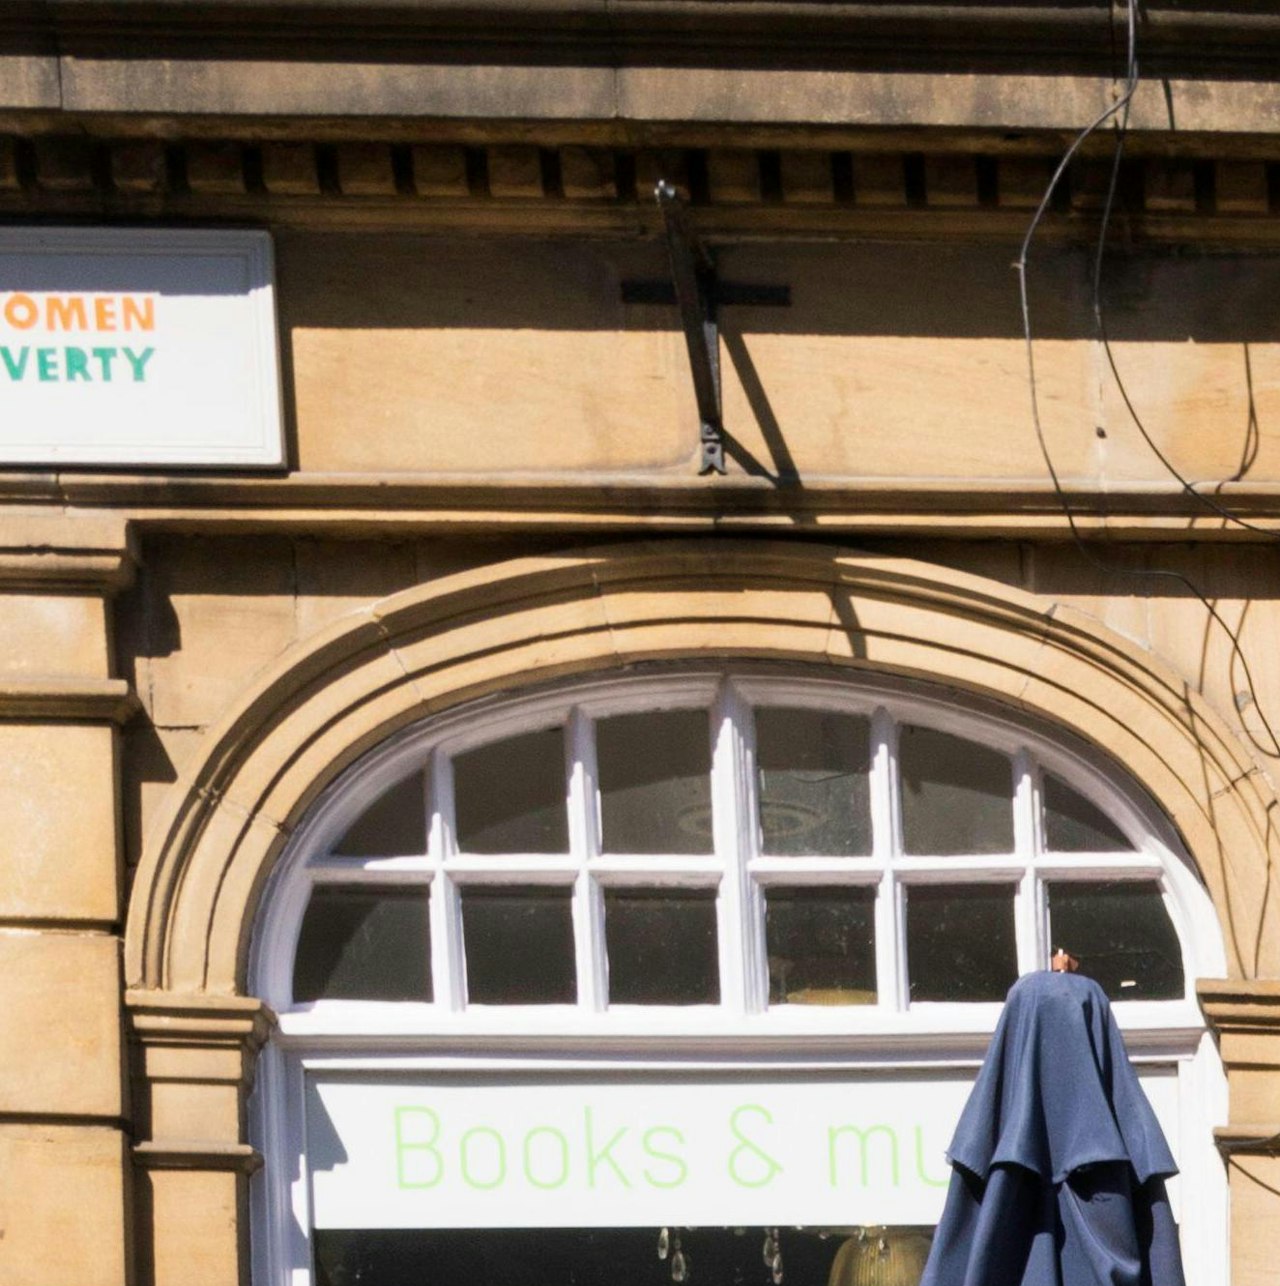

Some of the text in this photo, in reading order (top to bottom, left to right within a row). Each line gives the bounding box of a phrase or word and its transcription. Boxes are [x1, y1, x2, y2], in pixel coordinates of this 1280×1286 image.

[0, 345, 155, 381] VERTY
[393, 1105, 688, 1191] Books
[726, 1104, 785, 1190] &
